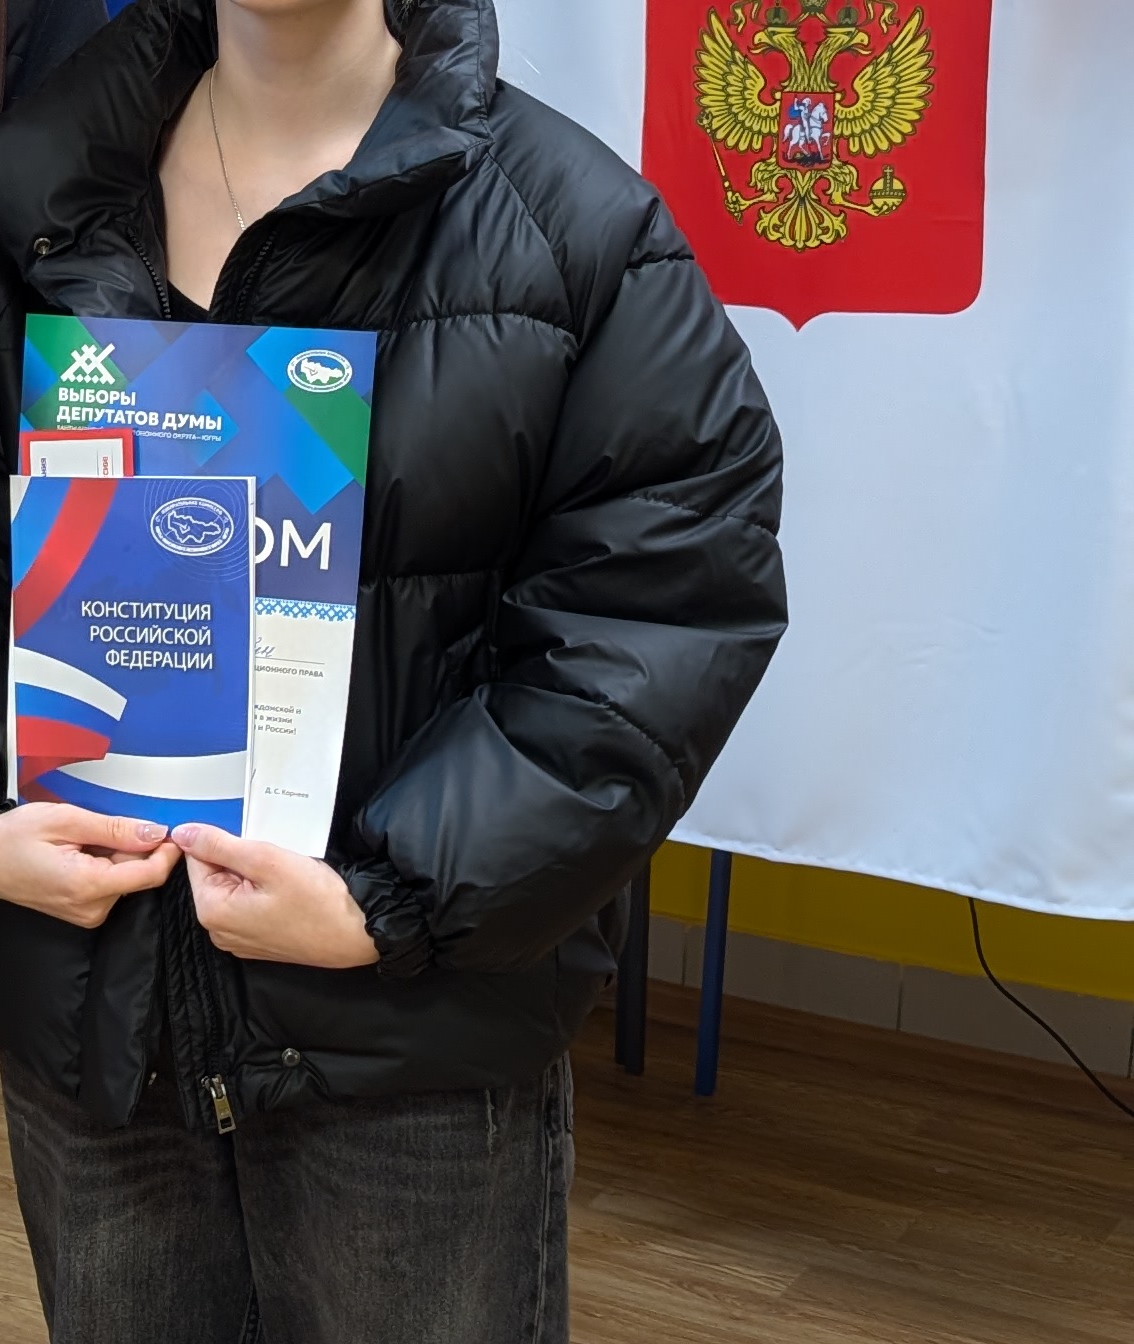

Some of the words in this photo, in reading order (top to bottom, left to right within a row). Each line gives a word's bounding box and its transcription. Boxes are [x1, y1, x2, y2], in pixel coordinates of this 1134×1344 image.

[58, 387, 136, 406] ВЫБОРЫ
[57, 406, 159, 426] ДЕПУТАТОВ
[162, 412, 222, 430] ДУМЫ
[81, 601, 211, 623] КОНСТИТУЦИЯ
[90, 624, 211, 645] РОССИЙСКОЙ
[106, 649, 213, 671] ФЕДЕРАЦИИ
[299, 669, 324, 678] ПРАВА
